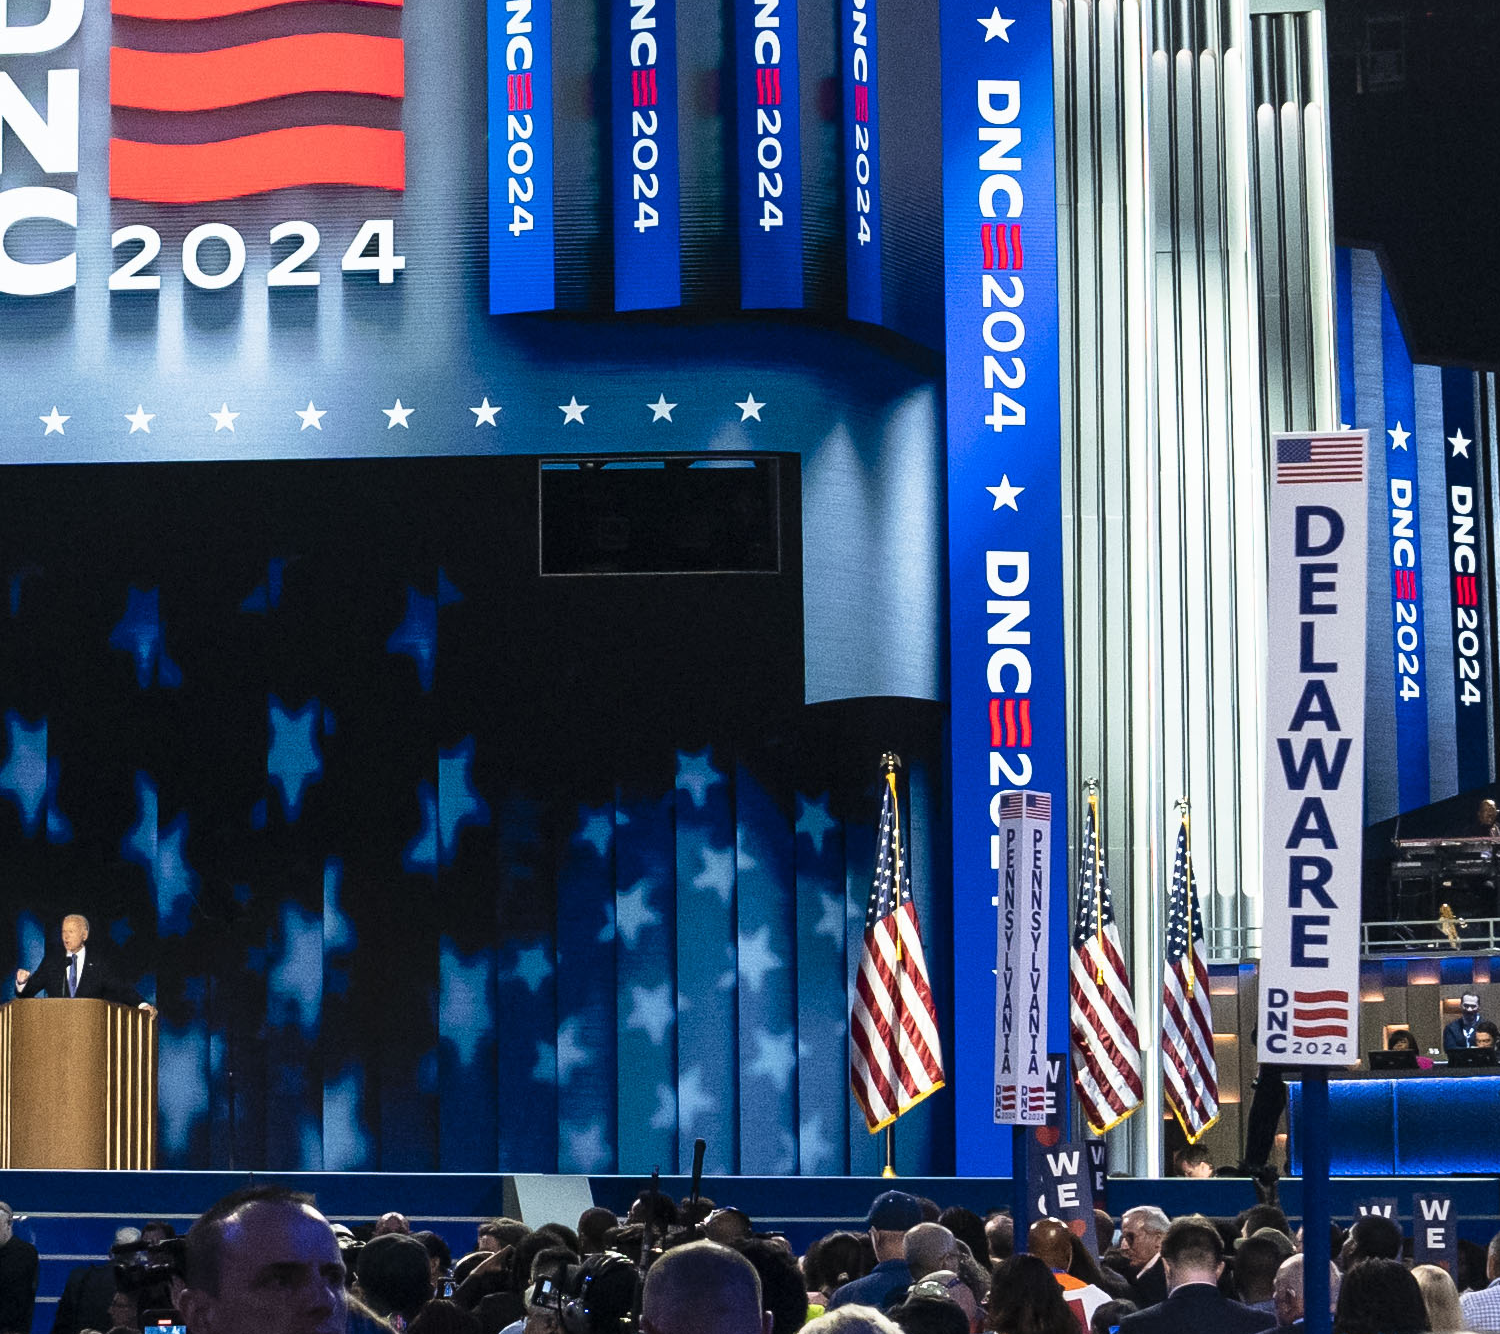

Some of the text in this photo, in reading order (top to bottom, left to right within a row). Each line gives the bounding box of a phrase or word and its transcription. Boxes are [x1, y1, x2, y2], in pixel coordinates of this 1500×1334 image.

[507, 114, 534, 237] 2024
[632, 110, 659, 233] 2024
[757, 108, 784, 232] 2024
[855, 124, 871, 246] 2024
[107, 218, 406, 292] 2024
[977, 79, 1026, 433] DNC 2024
[986, 550, 1032, 694] DNC
[1391, 478, 1420, 702] DNC 2024
[1451, 485, 1481, 706] DNC 2024
[1276, 504, 1353, 970] DELAWARE
[1001, 827, 1018, 1075] PENNSYLVANIA
[1027, 827, 1045, 1075] PENNSYLVANIA
[1266, 988, 1349, 1057] DNC 2024
[1046, 1151, 1080, 1208] WE
[1421, 1200, 1451, 1250] WE
